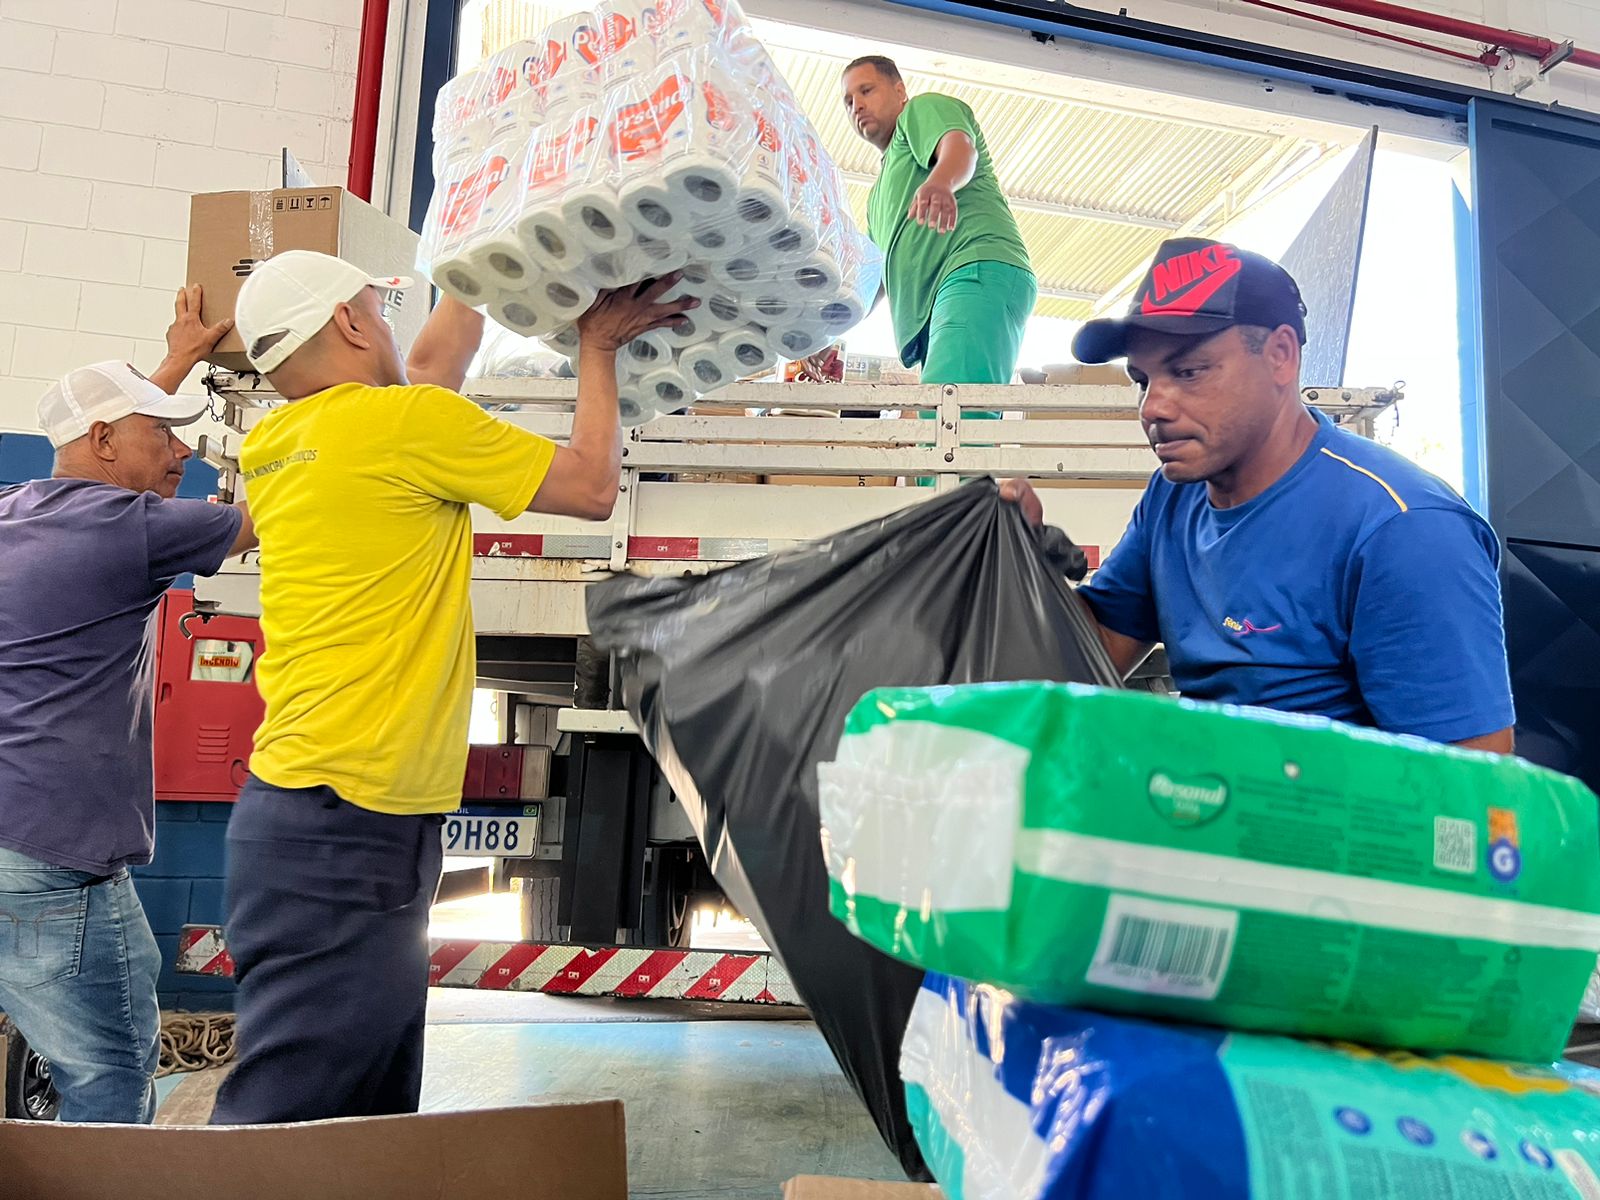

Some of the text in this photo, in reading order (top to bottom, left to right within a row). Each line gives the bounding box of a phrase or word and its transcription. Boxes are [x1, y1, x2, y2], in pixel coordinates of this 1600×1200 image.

[1152, 243, 1234, 301] NIKE
[446, 819, 519, 851] 9H88
[1492, 847, 1516, 874] G
